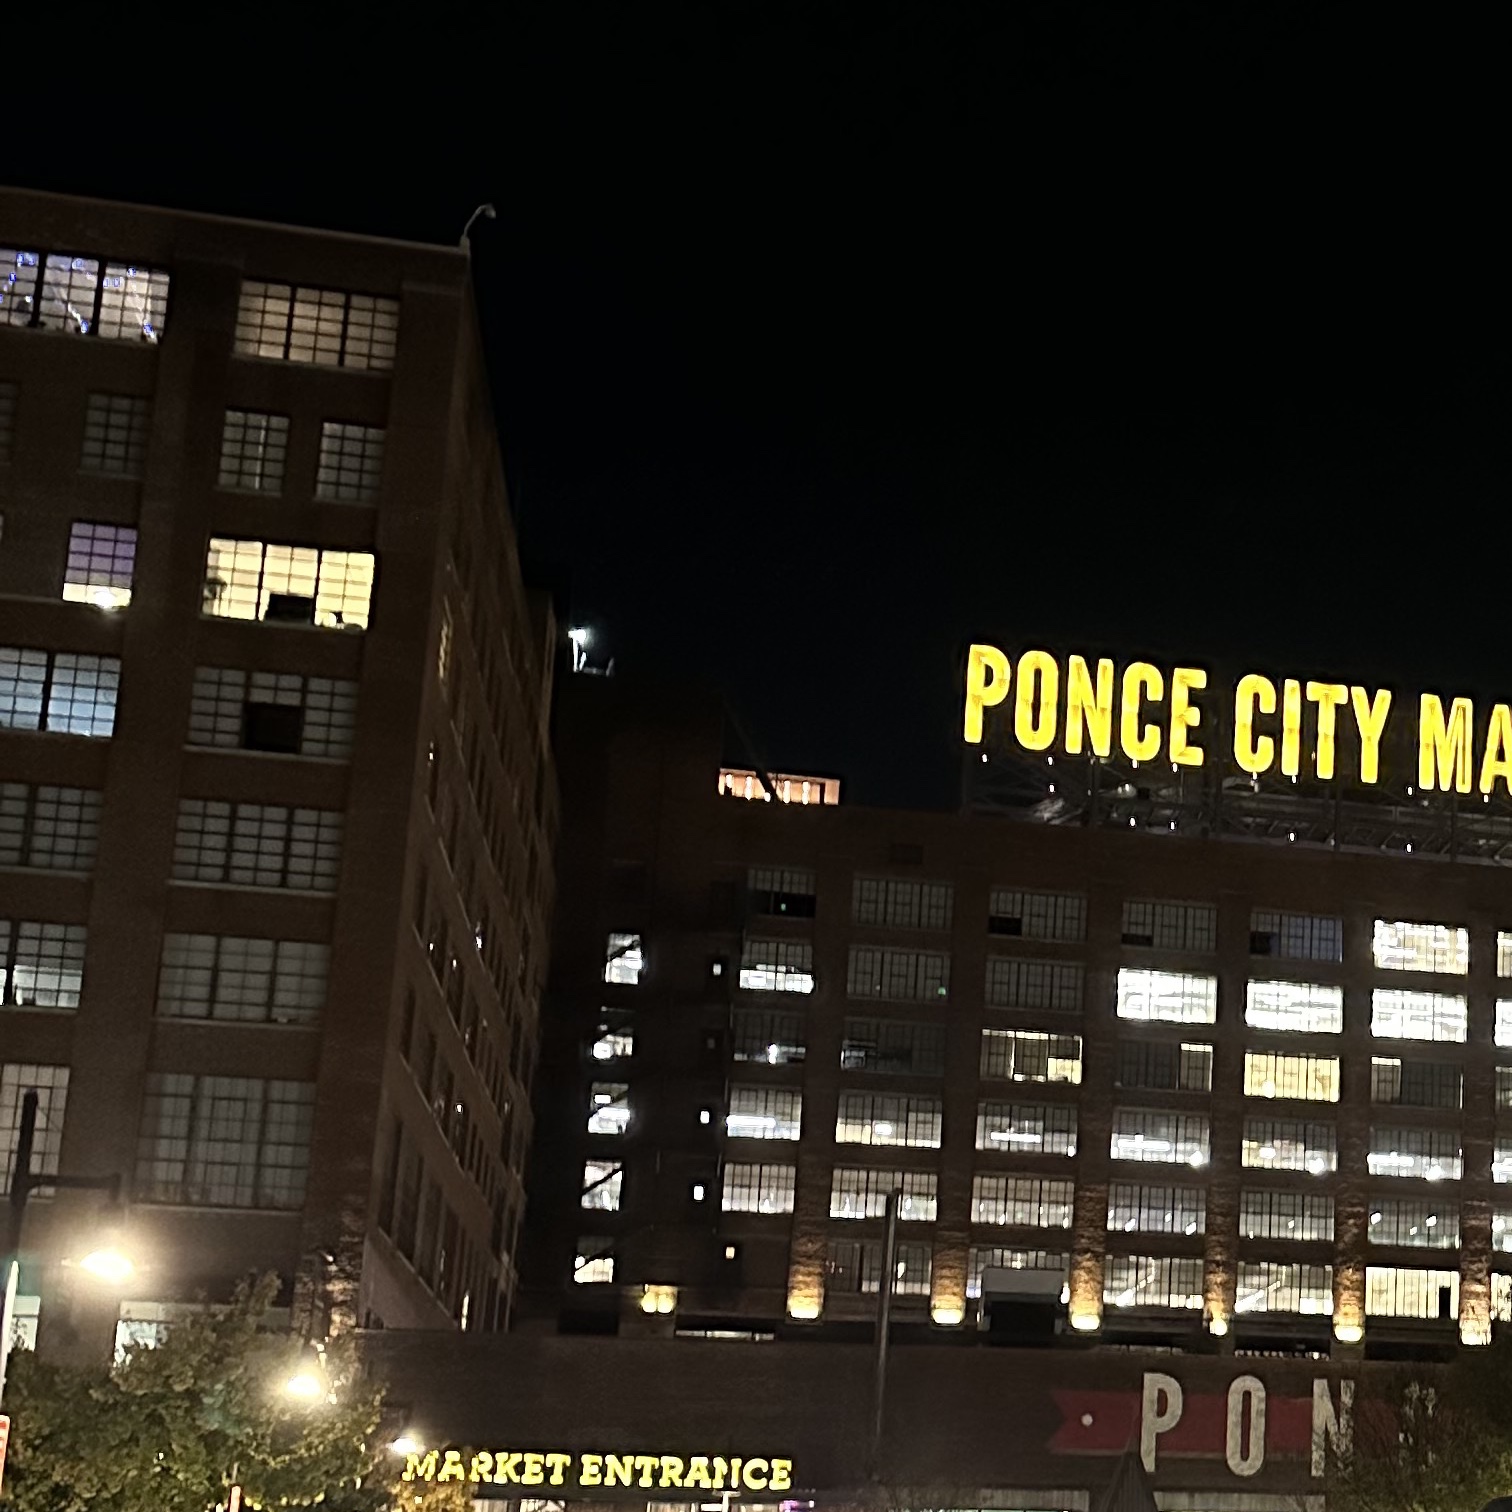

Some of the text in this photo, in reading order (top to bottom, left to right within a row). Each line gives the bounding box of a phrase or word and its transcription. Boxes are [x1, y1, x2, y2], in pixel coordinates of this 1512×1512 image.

[963, 644, 1207, 766] PONCE
[1233, 674, 1392, 784] CITY
[402, 1450, 793, 1491] MARKET ENTRANCE
[1141, 1372, 1437, 1477] PON
